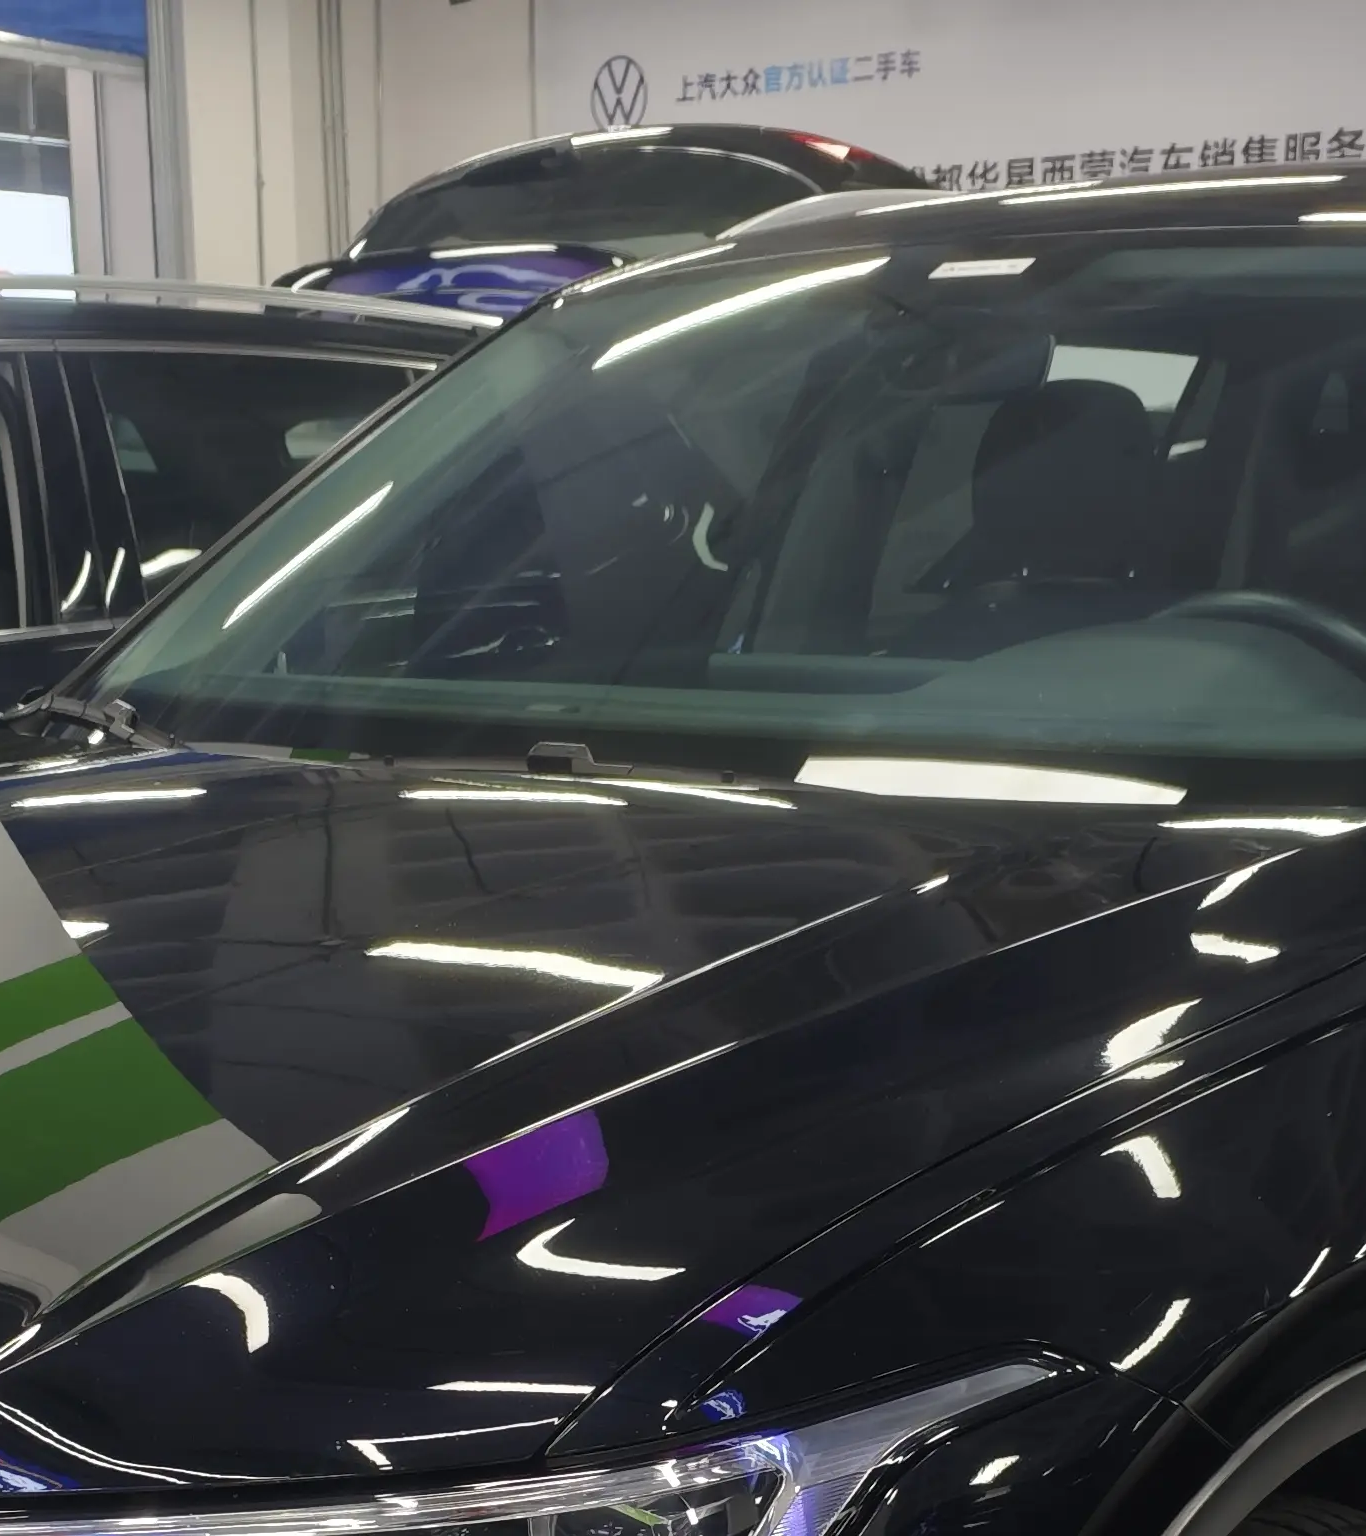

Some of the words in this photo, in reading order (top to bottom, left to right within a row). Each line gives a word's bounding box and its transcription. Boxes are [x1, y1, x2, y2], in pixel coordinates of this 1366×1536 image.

[675, 49, 922, 103] 上汽大众官方认证二手车
